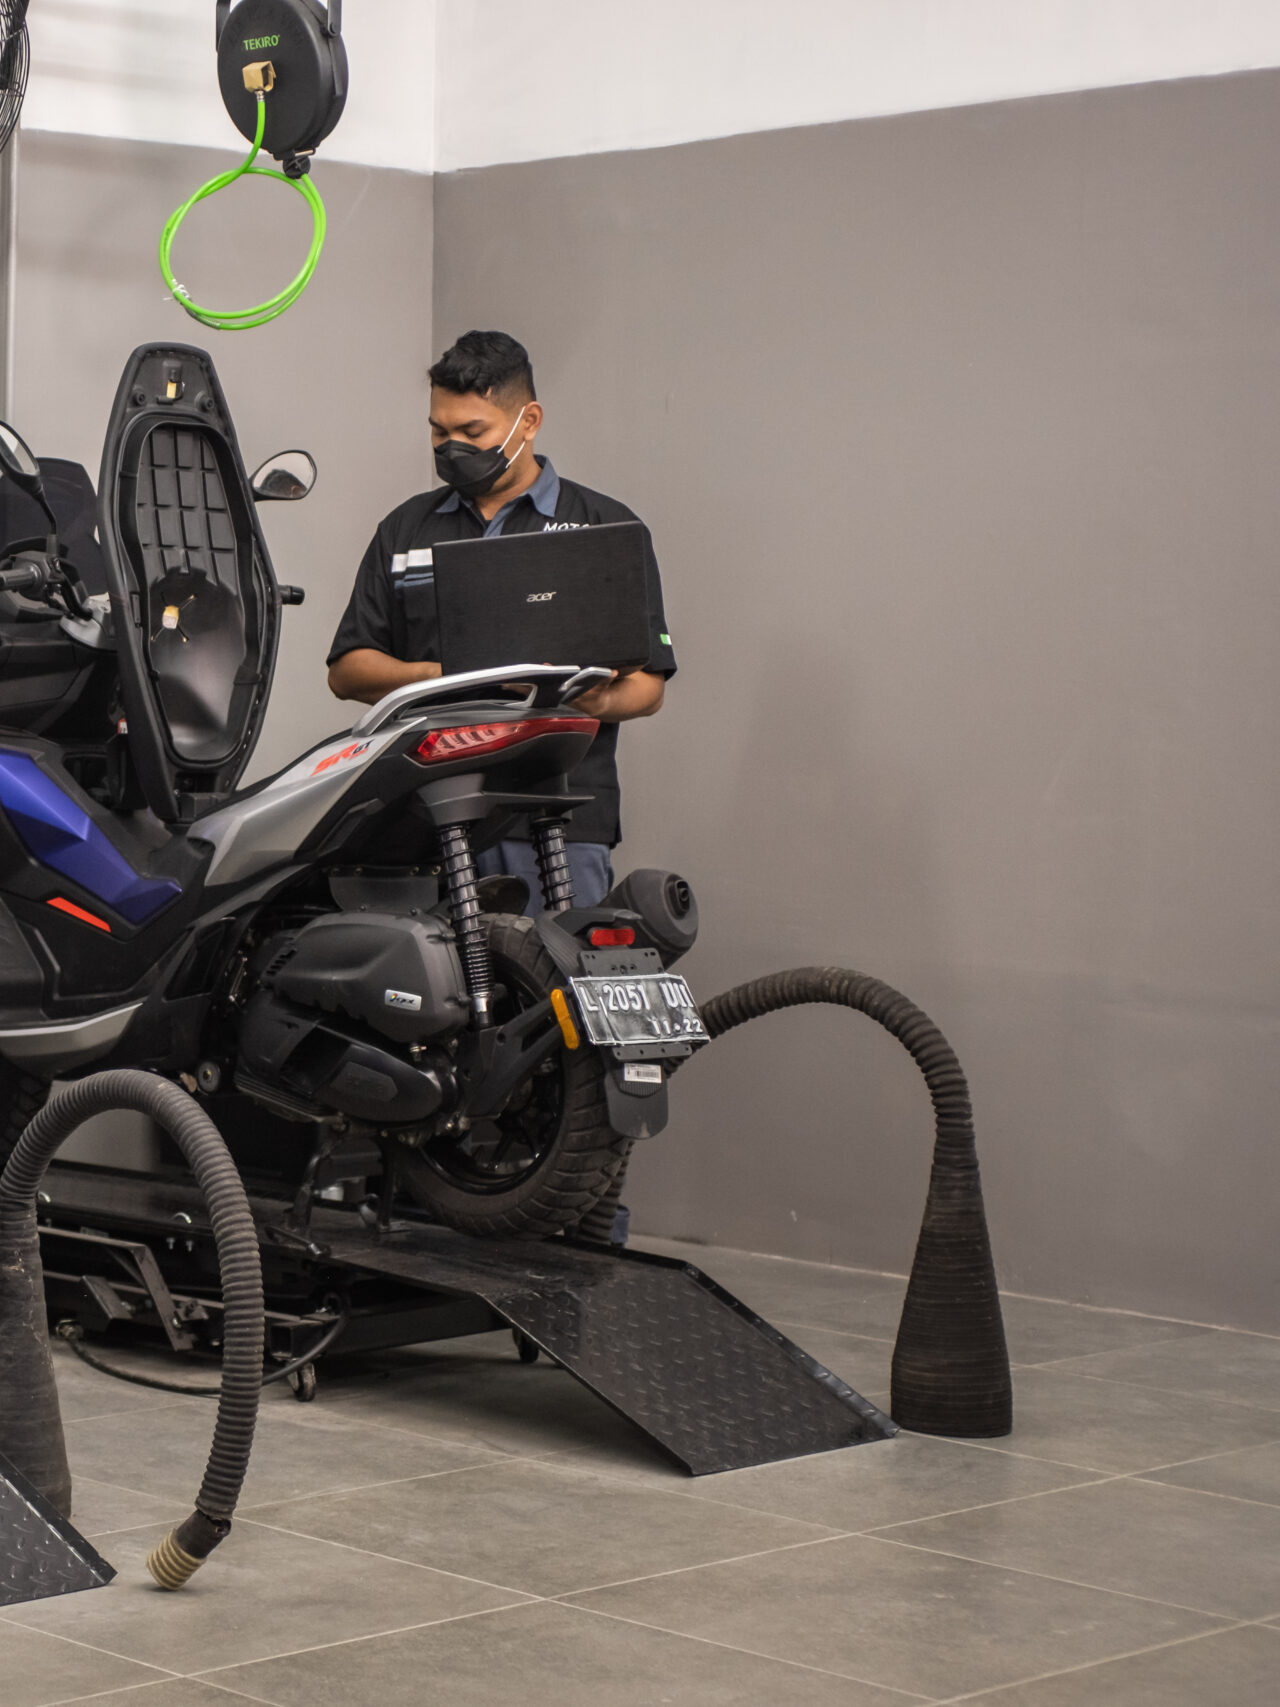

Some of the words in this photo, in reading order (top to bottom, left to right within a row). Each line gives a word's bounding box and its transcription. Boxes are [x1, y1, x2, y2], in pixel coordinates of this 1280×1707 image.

[243, 34, 280, 51] TEKIRO
[526, 591, 557, 602] acer
[579, 985, 599, 1011] L
[602, 984, 651, 1011] 2051
